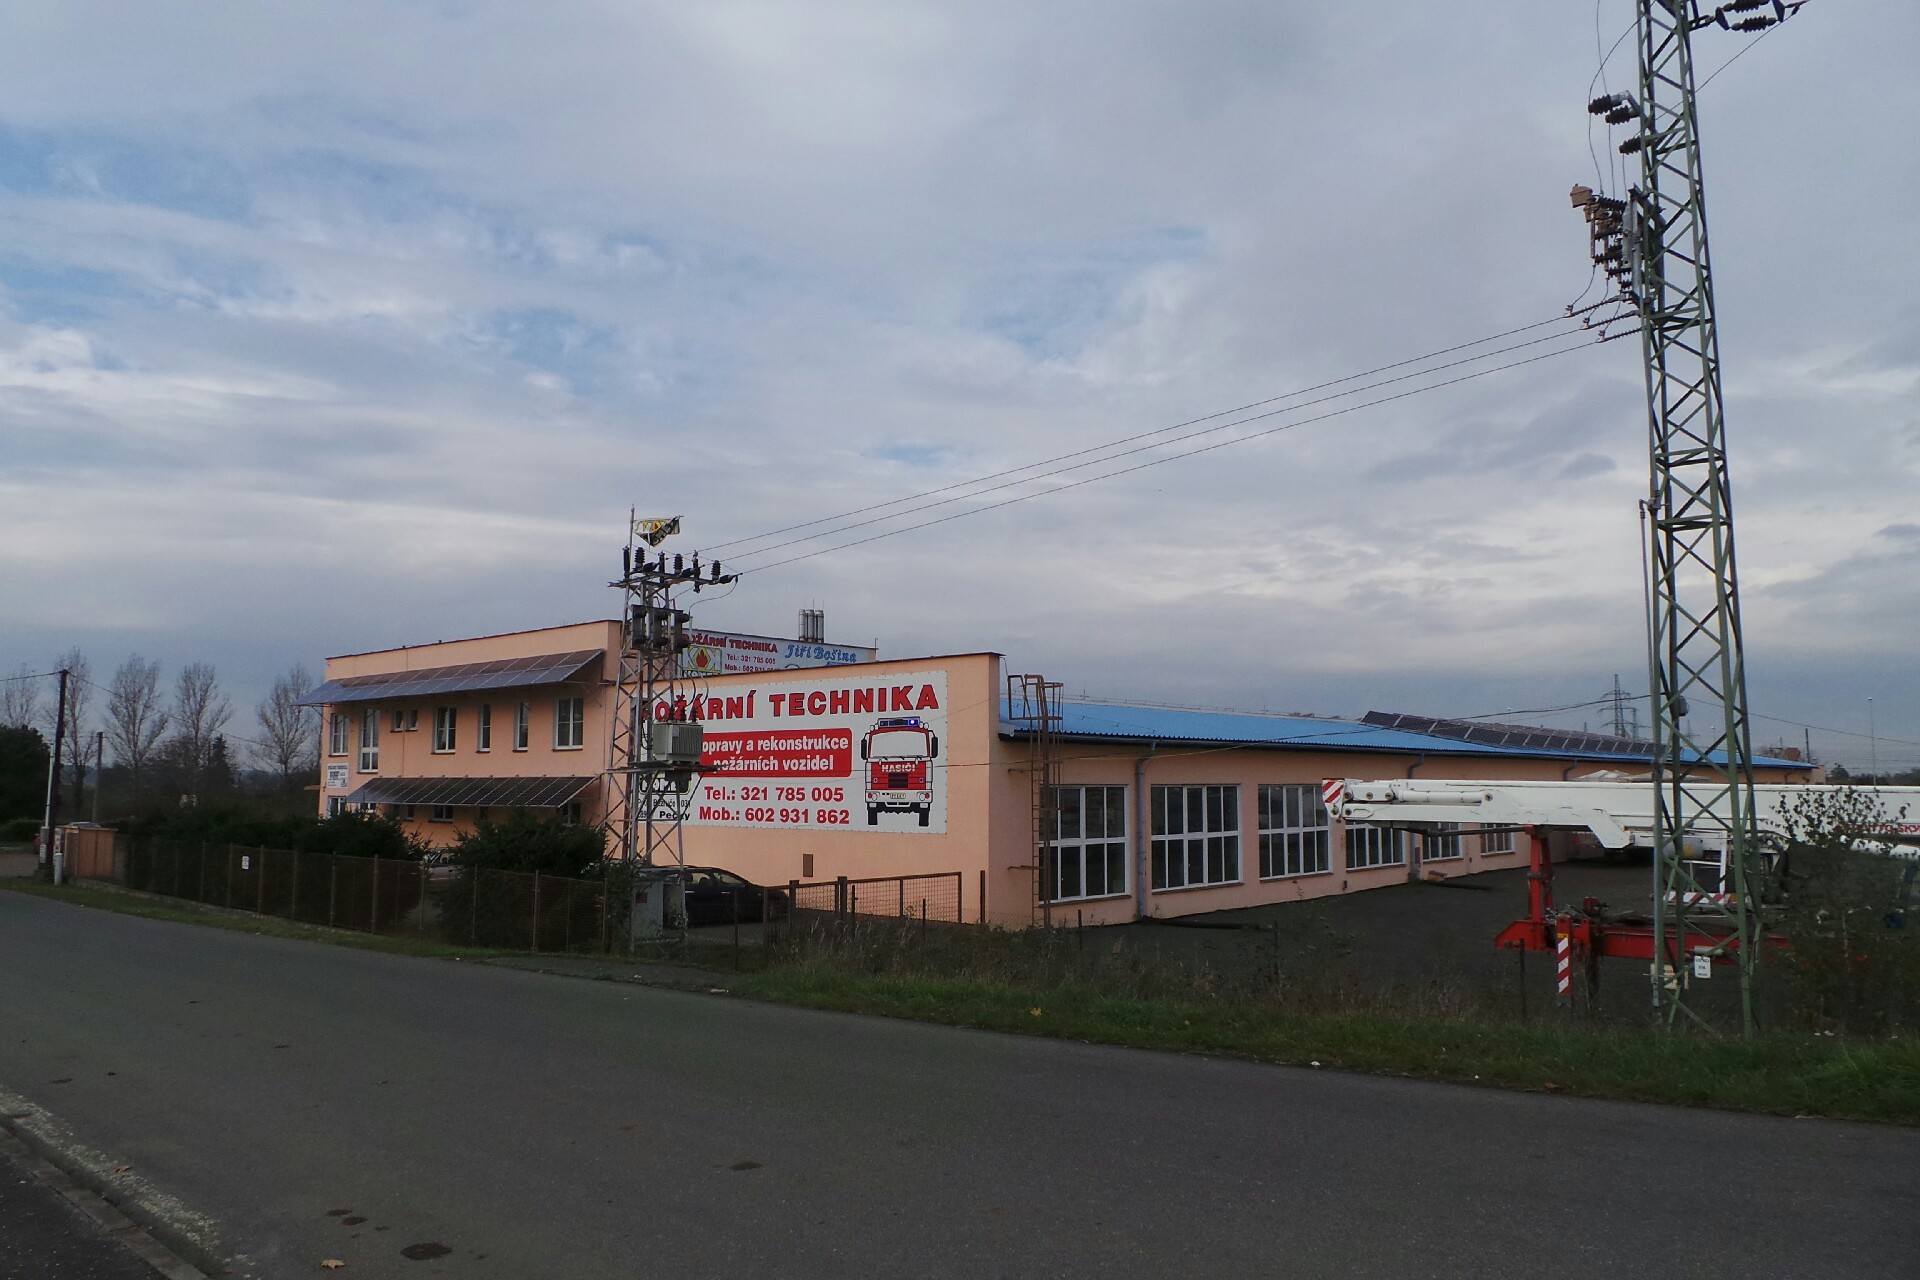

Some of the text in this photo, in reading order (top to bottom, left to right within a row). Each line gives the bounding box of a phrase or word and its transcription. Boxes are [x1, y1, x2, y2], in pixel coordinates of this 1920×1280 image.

[728, 639, 778, 653] TECHNIKA
[642, 684, 940, 722] OŽÁRNÍ TECHNIKA
[746, 740, 754, 751] a
[757, 735, 849, 752] rekonstrukce
[713, 750, 834, 774] požárních vozidel
[881, 762, 916, 773] HASIČI
[704, 786, 844, 803] Tel.: 321 785 005
[699, 806, 850, 825] Mob.: 602 931 862
